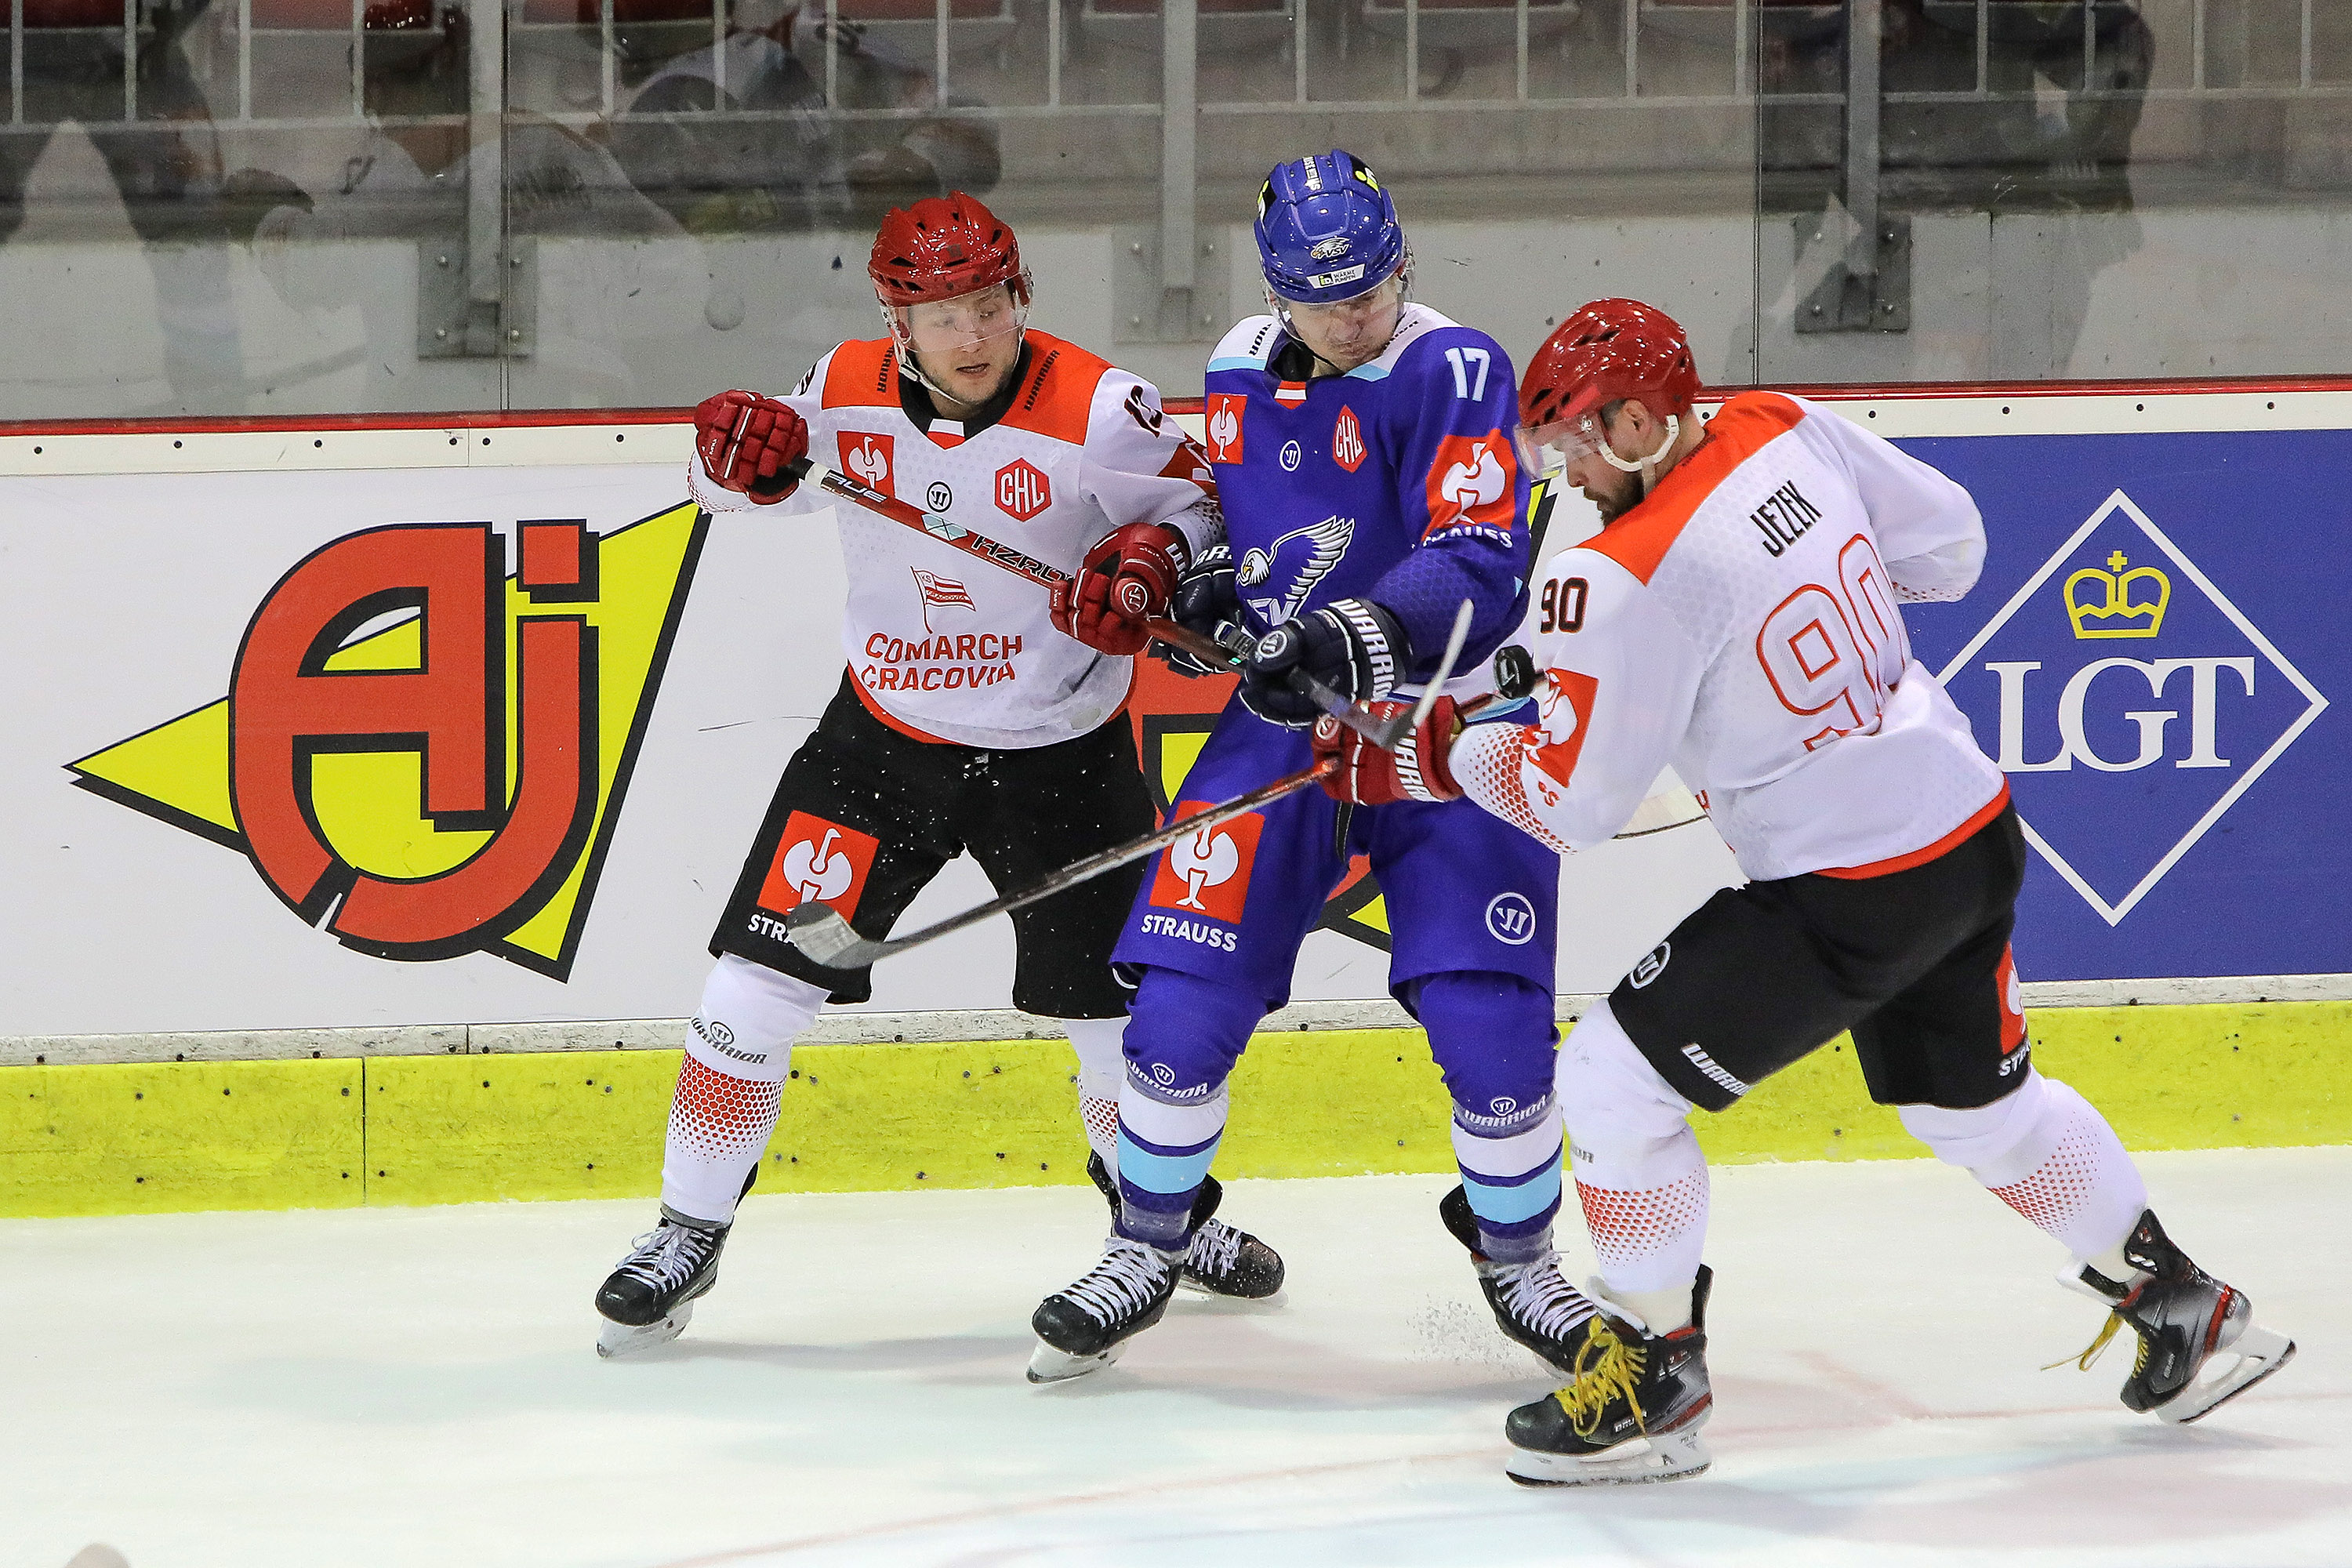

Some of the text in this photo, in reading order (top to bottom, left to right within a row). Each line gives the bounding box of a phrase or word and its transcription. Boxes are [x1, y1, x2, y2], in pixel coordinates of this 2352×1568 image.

[1023, 350, 1061, 412] WARRIOR
[1445, 347, 1492, 401] 17
[1335, 416, 1363, 464] CHL
[1000, 467, 1046, 514] CHL
[1749, 479, 1824, 557] JEZEK
[1540, 577, 1589, 633] 90
[866, 632, 1022, 664] COMARCH
[1756, 533, 1911, 753] 90
[861, 662, 1016, 691] CRACOVIA
[1985, 656, 2256, 772] LGT
[1141, 914, 1238, 952] STRAUSS
[1127, 1059, 1208, 1098] WARRIOR
[1465, 1094, 1546, 1127] WARRIOR
